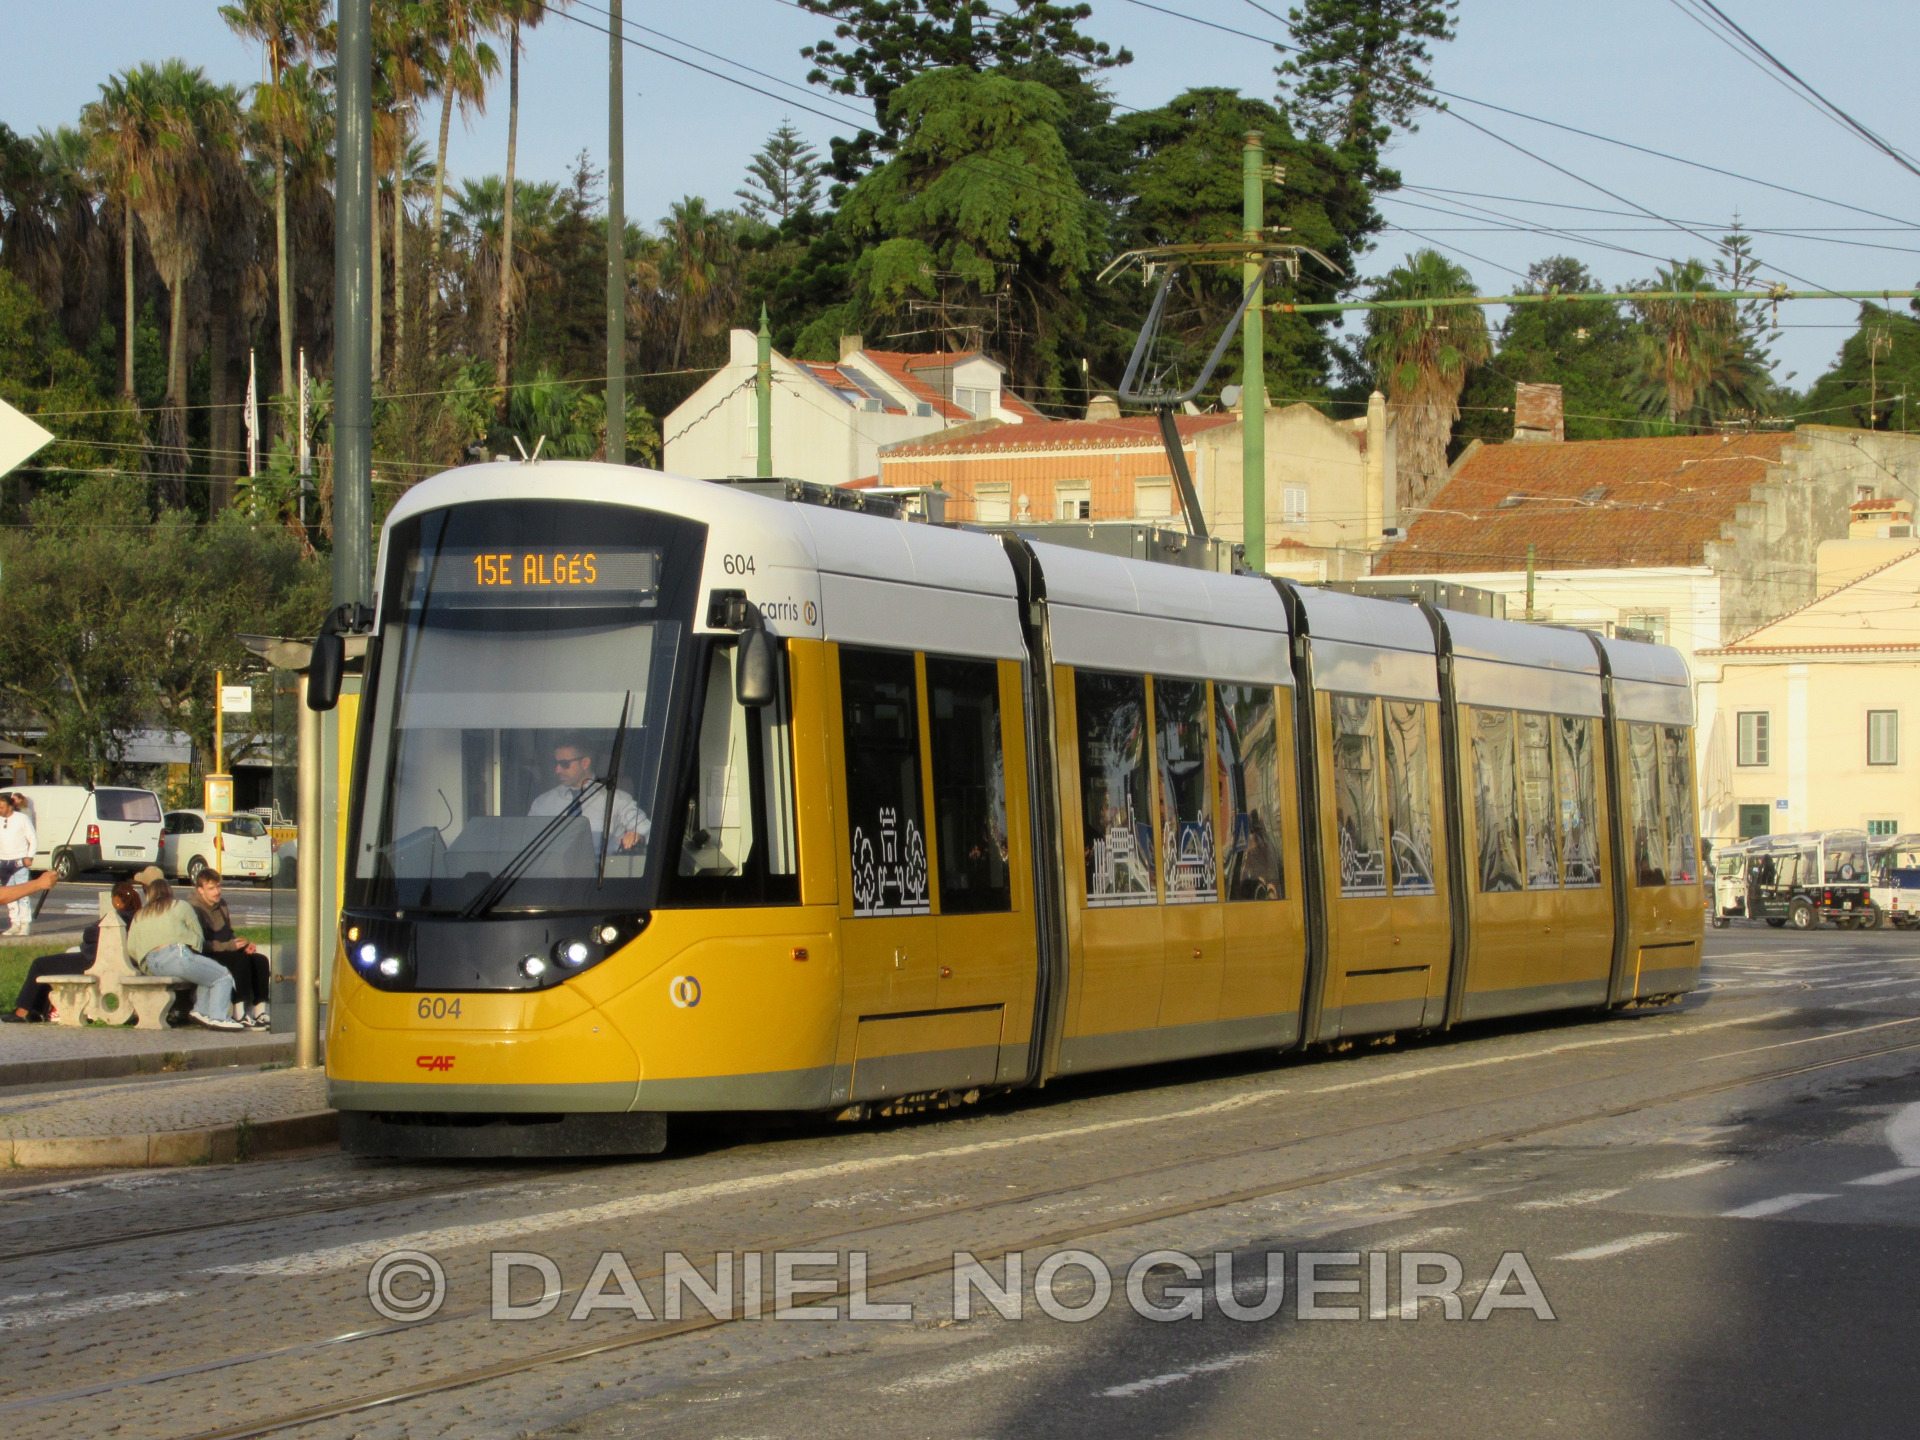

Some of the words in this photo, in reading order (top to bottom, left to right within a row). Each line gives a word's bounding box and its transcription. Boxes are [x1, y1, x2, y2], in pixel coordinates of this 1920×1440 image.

[473, 554, 512, 585] 15E
[723, 554, 756, 576] 604
[759, 596, 799, 621] carris
[417, 997, 462, 1020] 604
[416, 1055, 456, 1072] CAF
